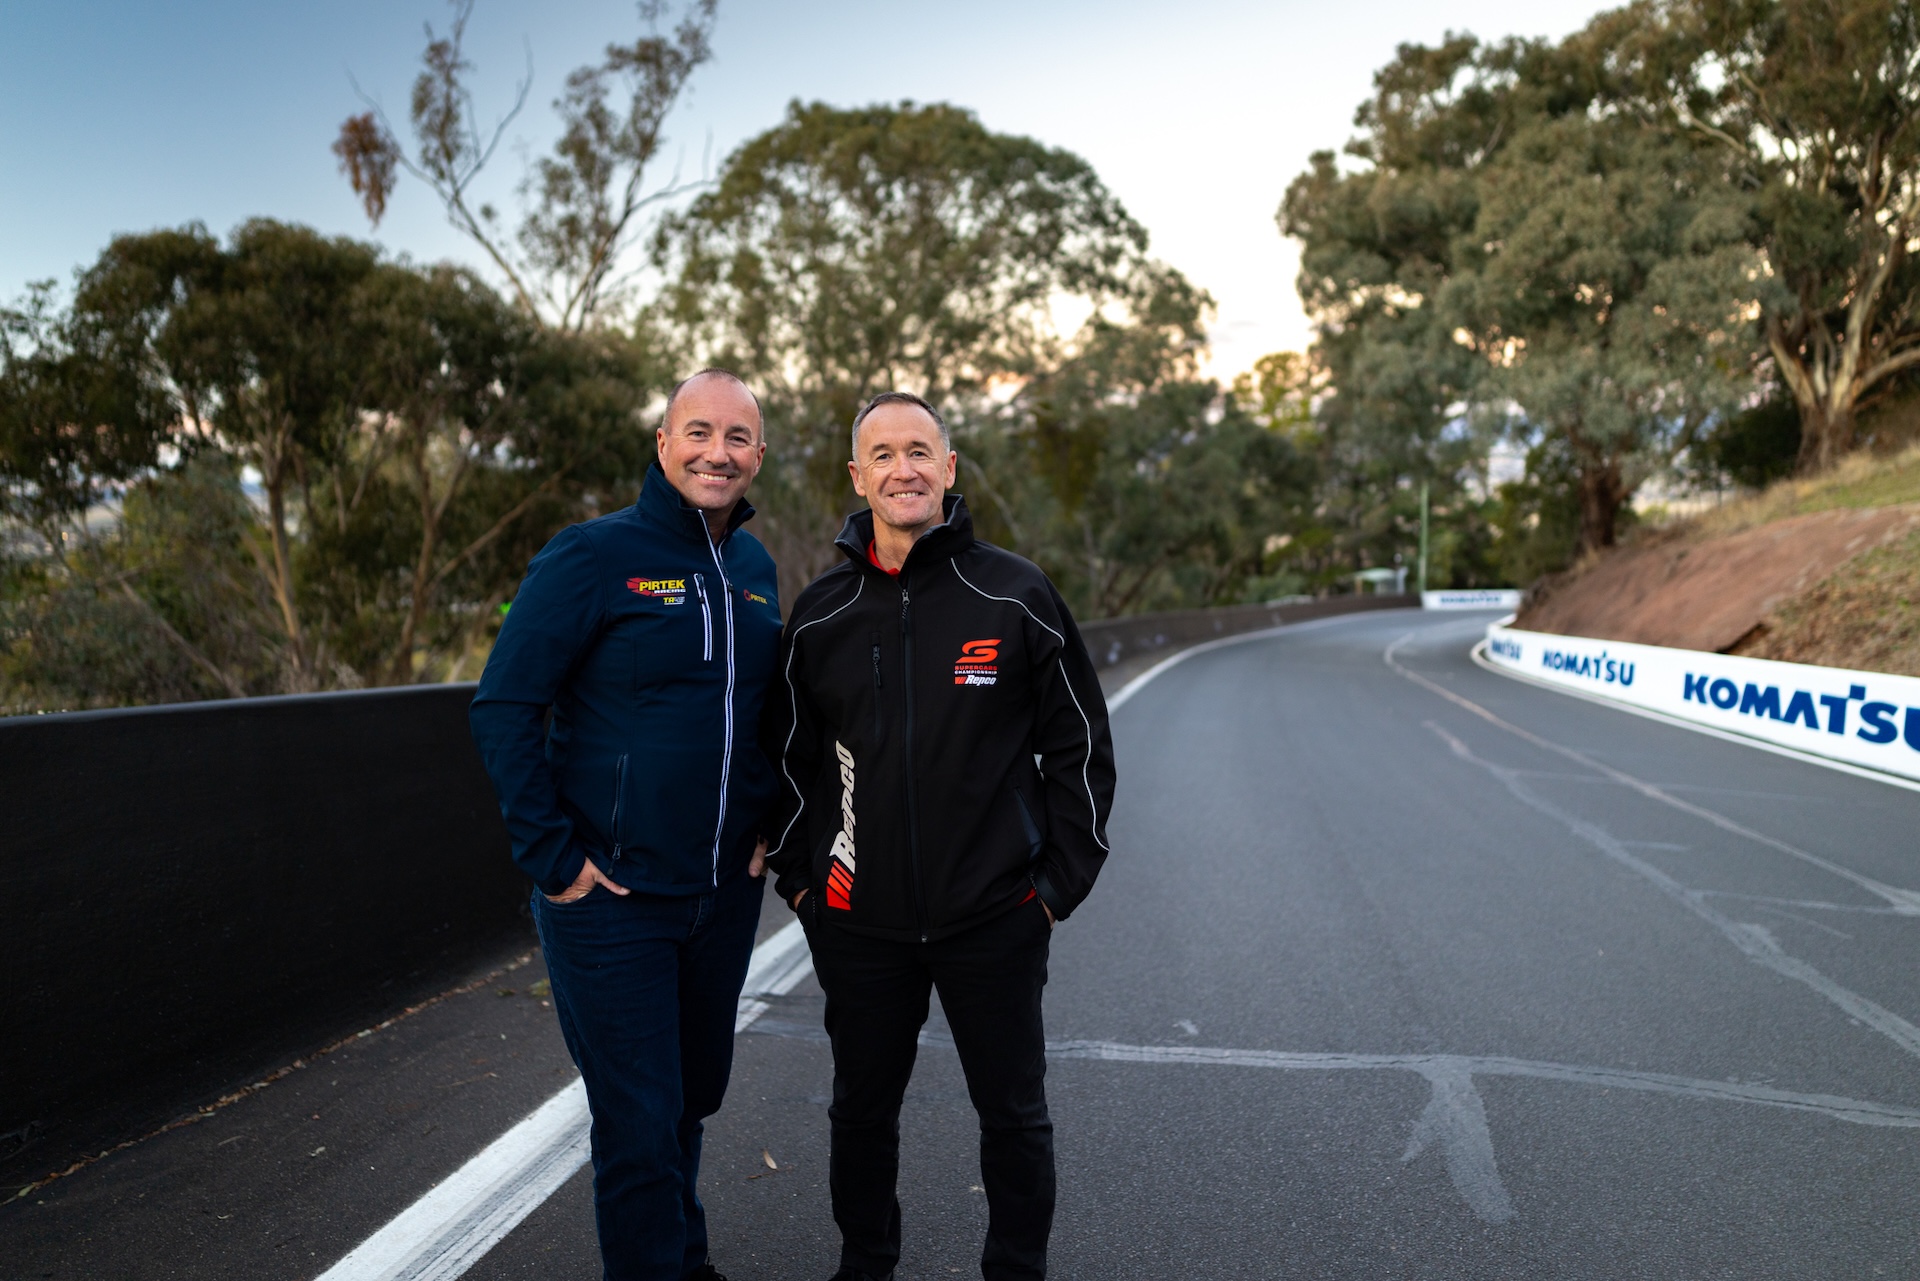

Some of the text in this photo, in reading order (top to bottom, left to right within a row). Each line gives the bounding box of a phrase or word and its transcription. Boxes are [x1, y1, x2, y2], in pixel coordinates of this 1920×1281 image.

[639, 579, 686, 592] PIRTEK
[964, 674, 997, 687] Repco
[1543, 649, 1635, 687] KOMATSU
[829, 739, 856, 874] Repco
